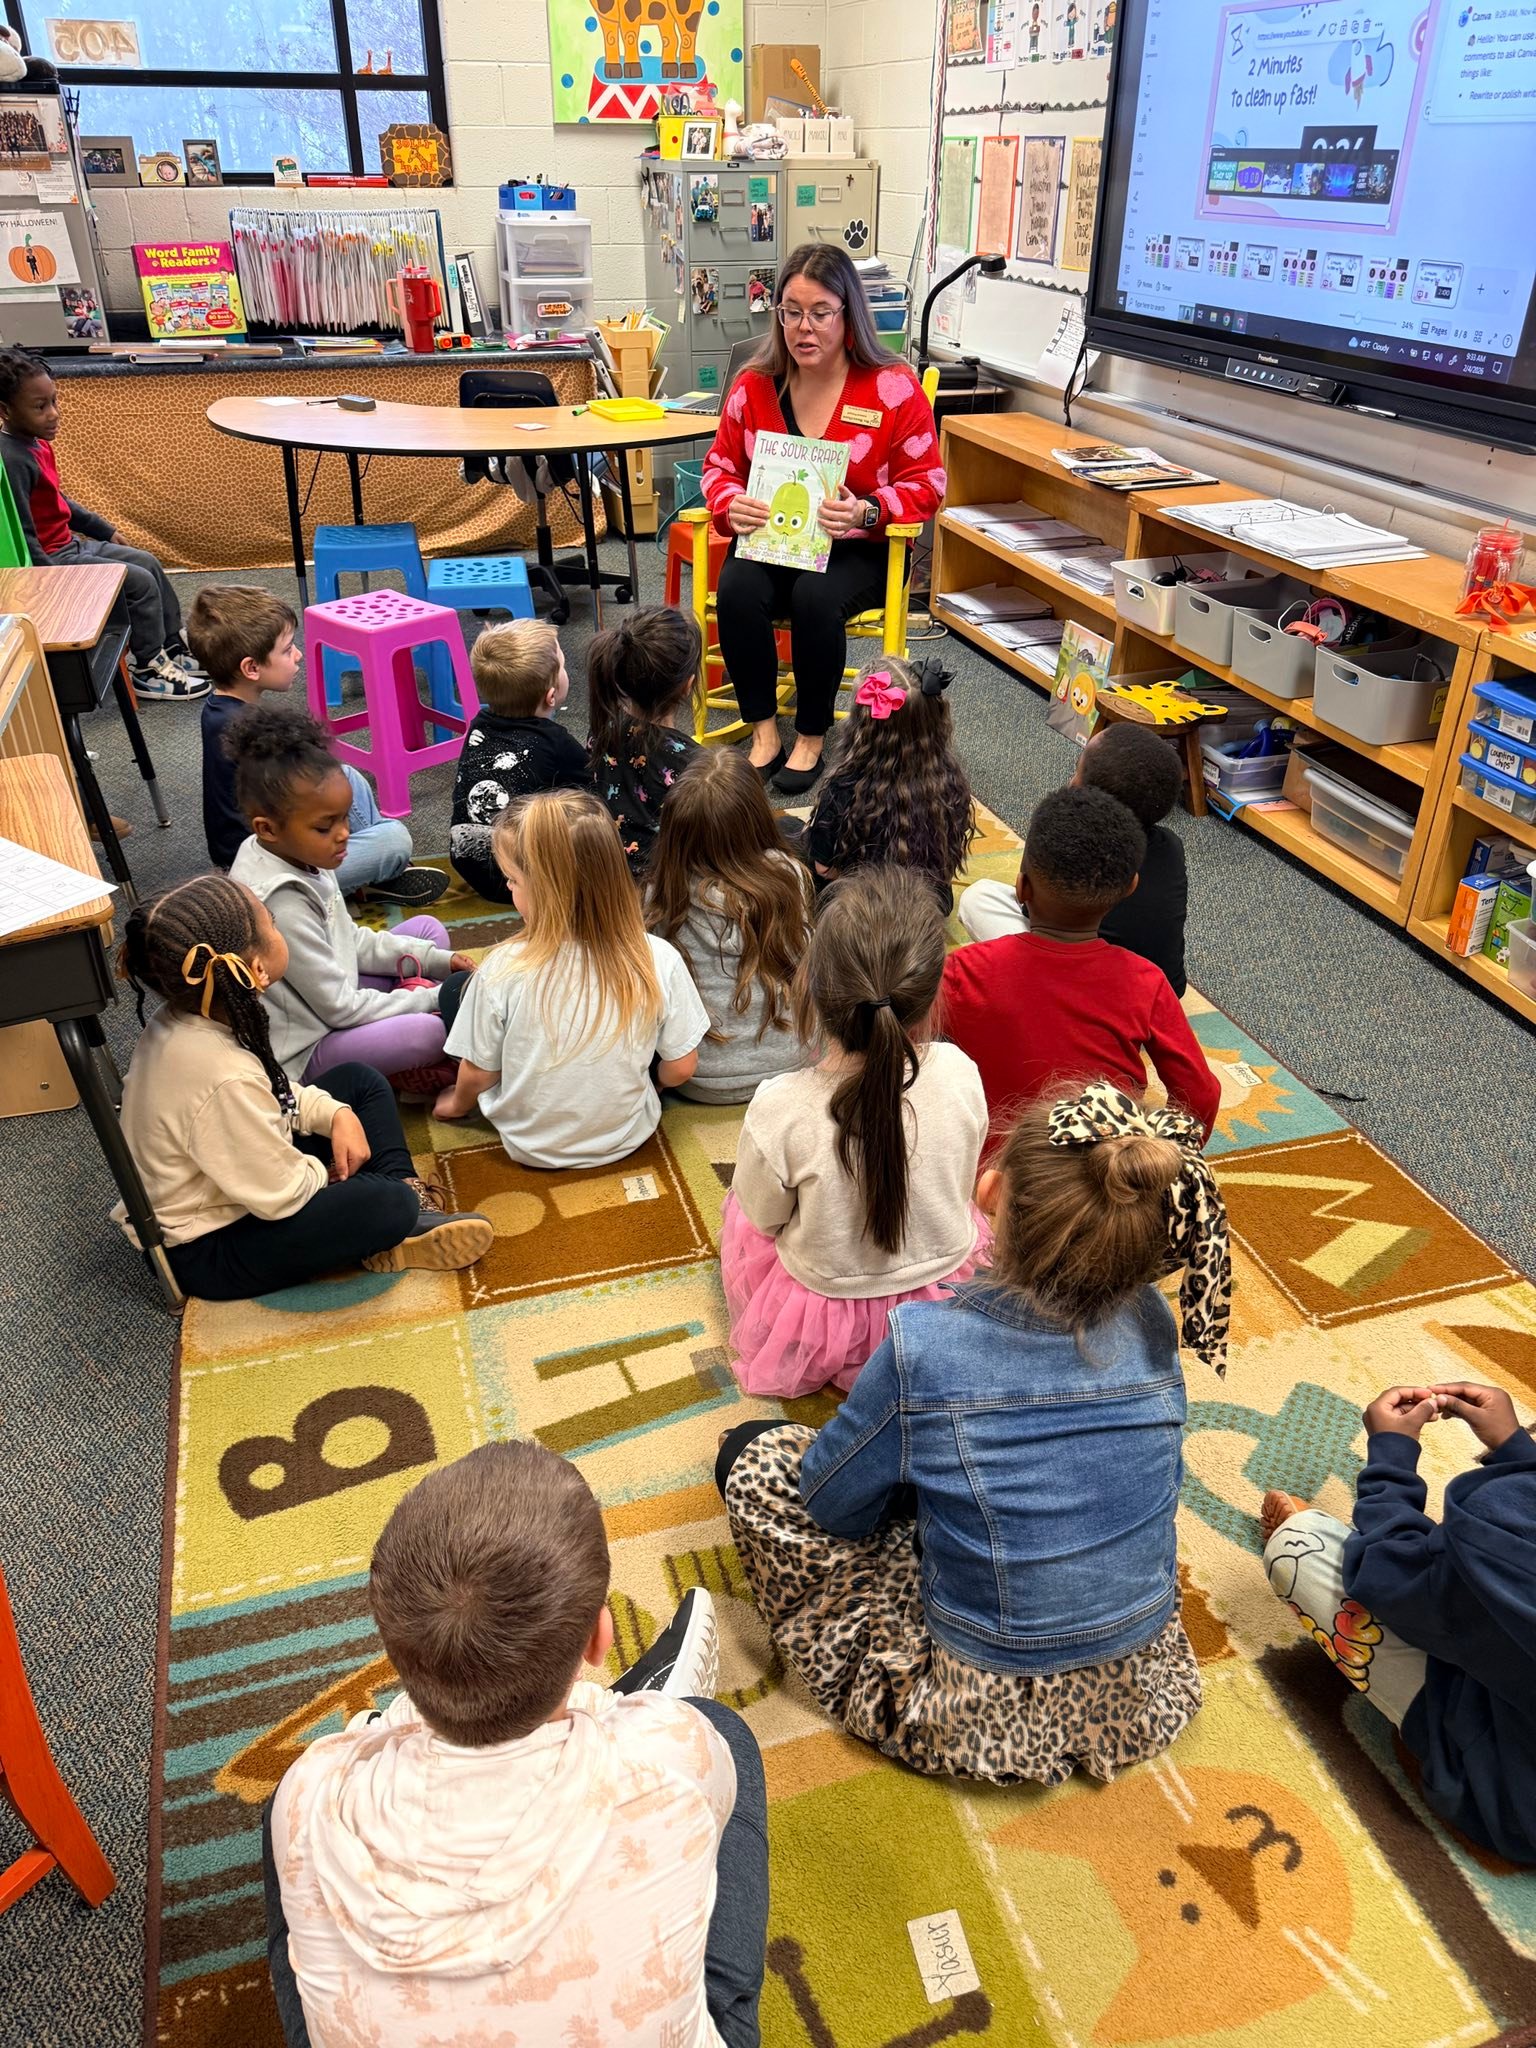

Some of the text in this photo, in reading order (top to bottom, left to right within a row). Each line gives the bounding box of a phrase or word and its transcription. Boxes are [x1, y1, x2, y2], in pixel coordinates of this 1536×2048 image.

[1472, 12, 1492, 22] Canva
[1497, 34, 1508, 42] You
[1509, 33, 1522, 42] can
[1522, 32, 1535, 40] use
[1464, 52, 1496, 62] comments
[1497, 52, 1504, 60] to
[1505, 50, 1516, 59] ask
[1248, 54, 1303, 77] 2 Minutes
[1460, 69, 1479, 80] things
[1232, 83, 1318, 115] to clean up fast!
[1502, 90, 1522, 100] polish
[10, 218, 58, 228] HALLOWEEN!
[144, 245, 220, 260] Word Family
[160, 257, 211, 268] Readers
[1430, 325, 1448, 338] Pages
[1372, 341, 1390, 354] Cloudy
[1476, 354, 1486, 362] AM
[760, 438, 844, 466] THE SOUR GRAPE
[217, 1385, 437, 1521] B
